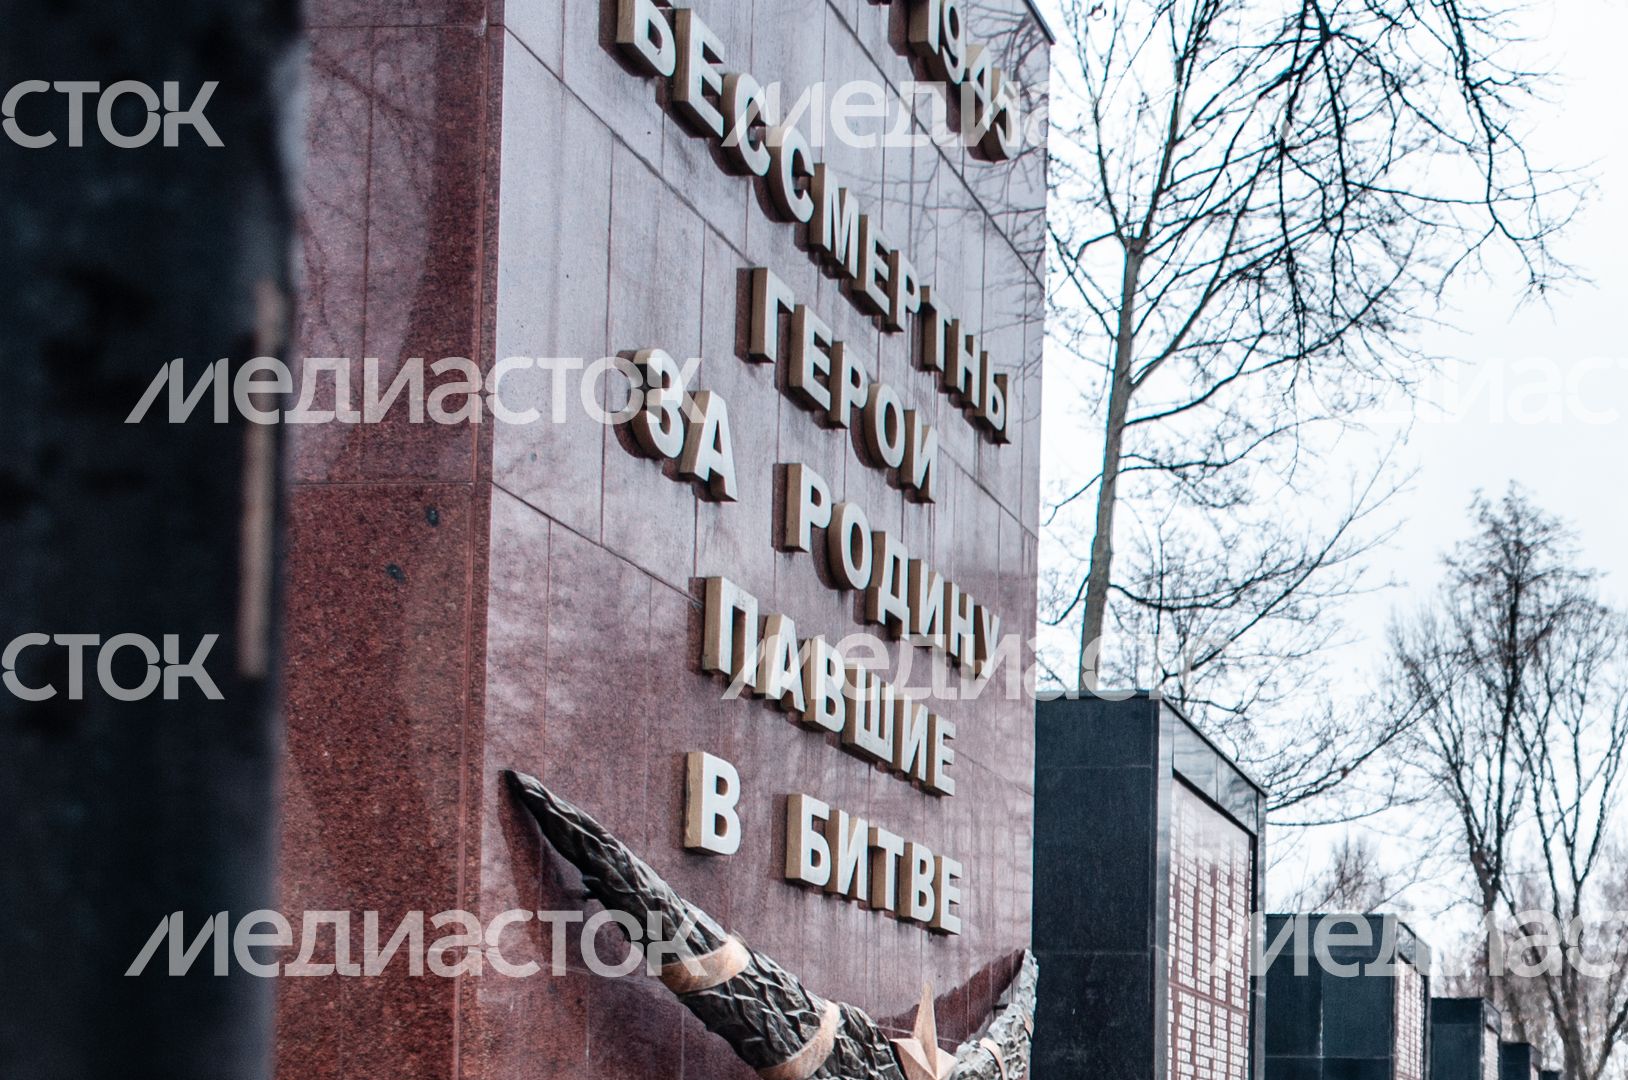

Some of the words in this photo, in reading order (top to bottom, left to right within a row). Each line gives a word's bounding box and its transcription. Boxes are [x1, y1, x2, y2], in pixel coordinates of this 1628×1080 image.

[750, 267, 935, 503] ГЕРОИ
[622, 348, 738, 502] ЗА
[785, 463, 1001, 679] РОДИНУ
[702, 576, 956, 797] ПАВШИЕ
[684, 751, 742, 857] В
[786, 793, 963, 936] БИТВЕ
